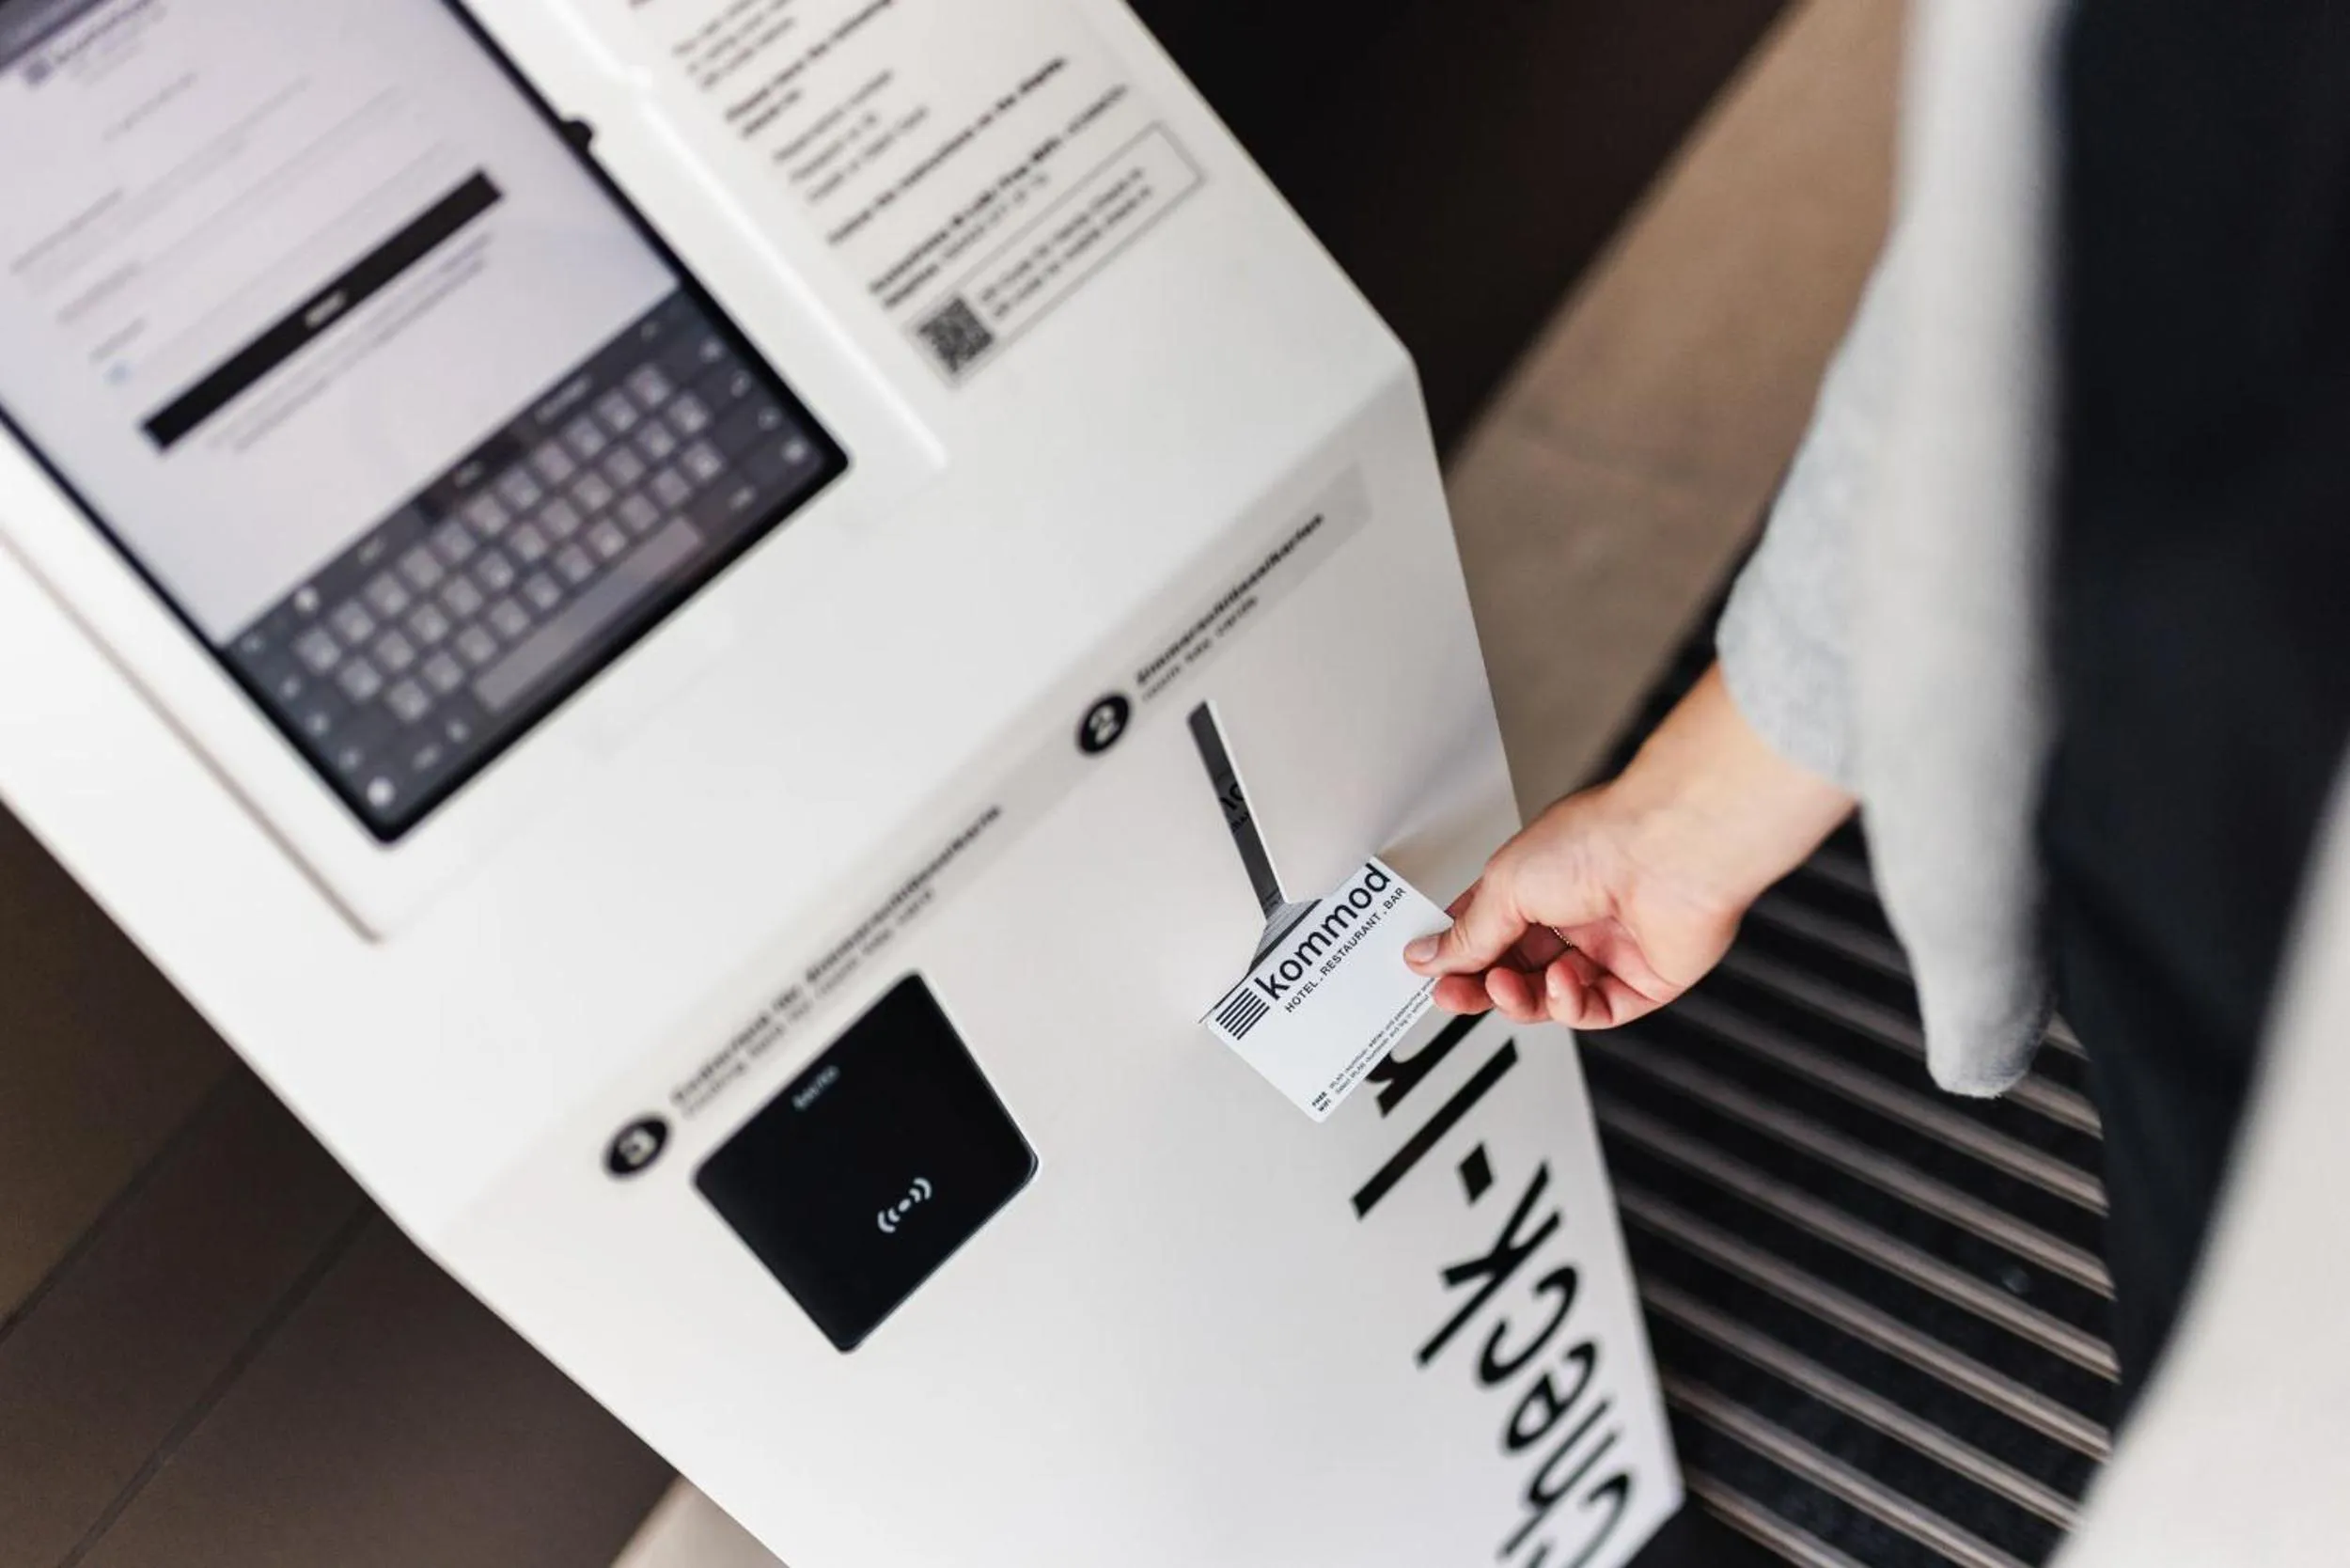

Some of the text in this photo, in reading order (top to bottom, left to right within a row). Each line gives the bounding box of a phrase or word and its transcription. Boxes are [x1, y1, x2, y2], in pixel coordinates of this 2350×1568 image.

[1254, 862, 1391, 1002] kommod
[1284, 979, 1319, 1013] HOTEL
[1320, 912, 1382, 977] RESTAURANT
[1383, 886, 1407, 911] BAR
